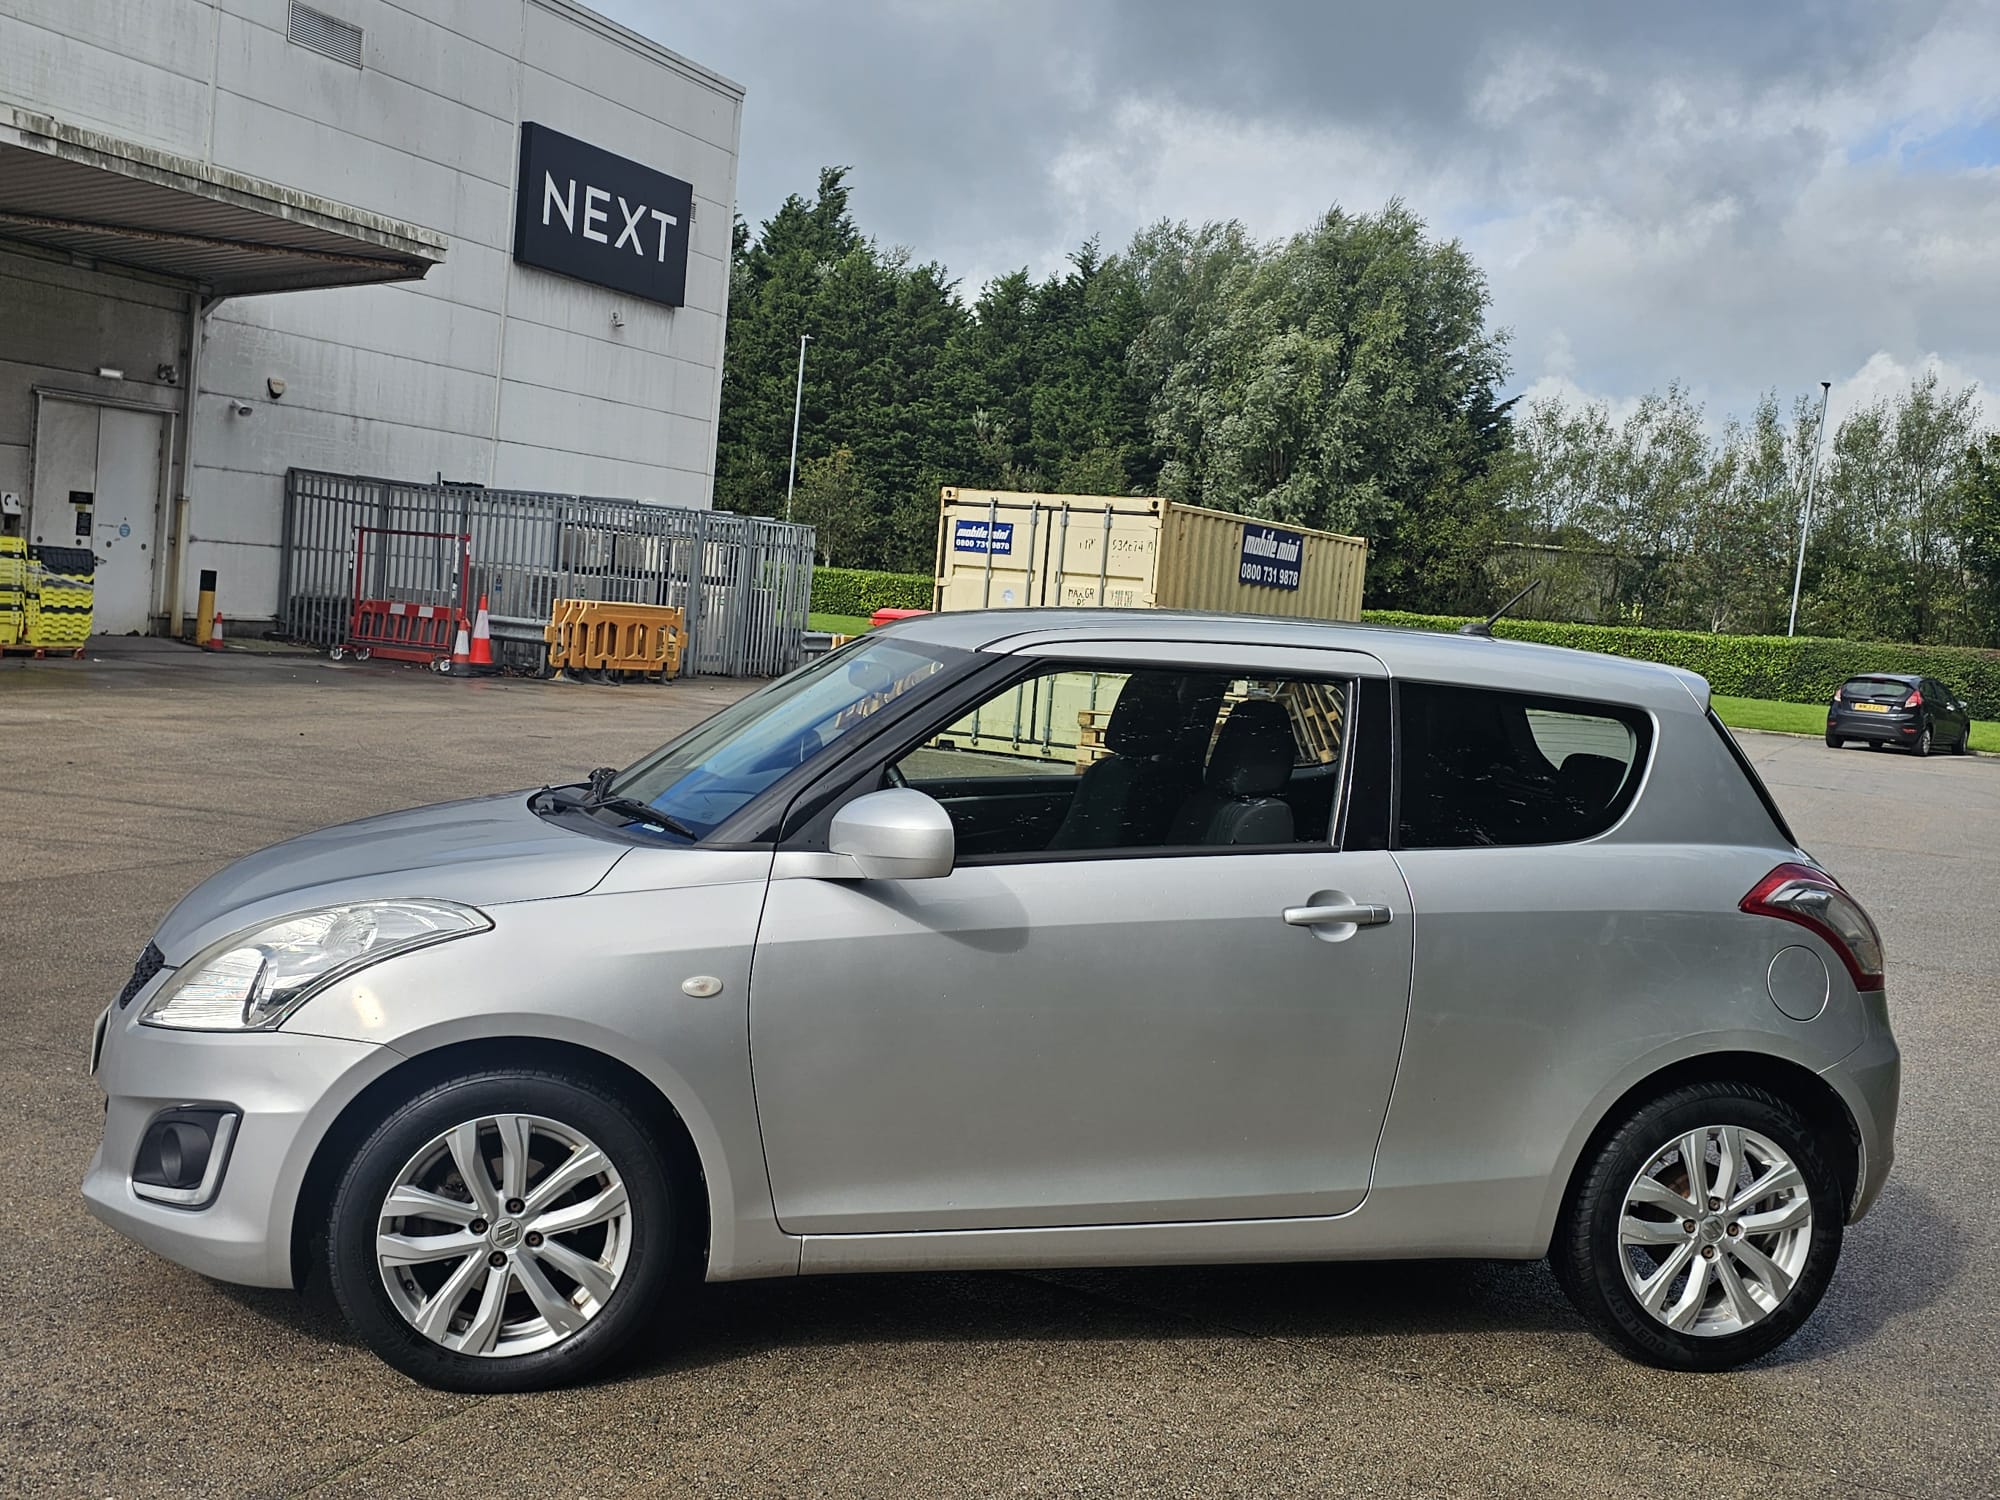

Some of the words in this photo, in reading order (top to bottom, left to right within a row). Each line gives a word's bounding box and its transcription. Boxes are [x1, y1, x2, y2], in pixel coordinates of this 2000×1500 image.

[542, 169, 678, 263] NEXT
[955, 539, 975, 547] 0800
[956, 525, 988, 538] mobile
[1243, 529, 1278, 558] mobile
[1276, 539, 1301, 563] mini
[1241, 562, 1261, 581] 0800
[1263, 566, 1278, 583] 731
[1279, 569, 1299, 586] 9878
